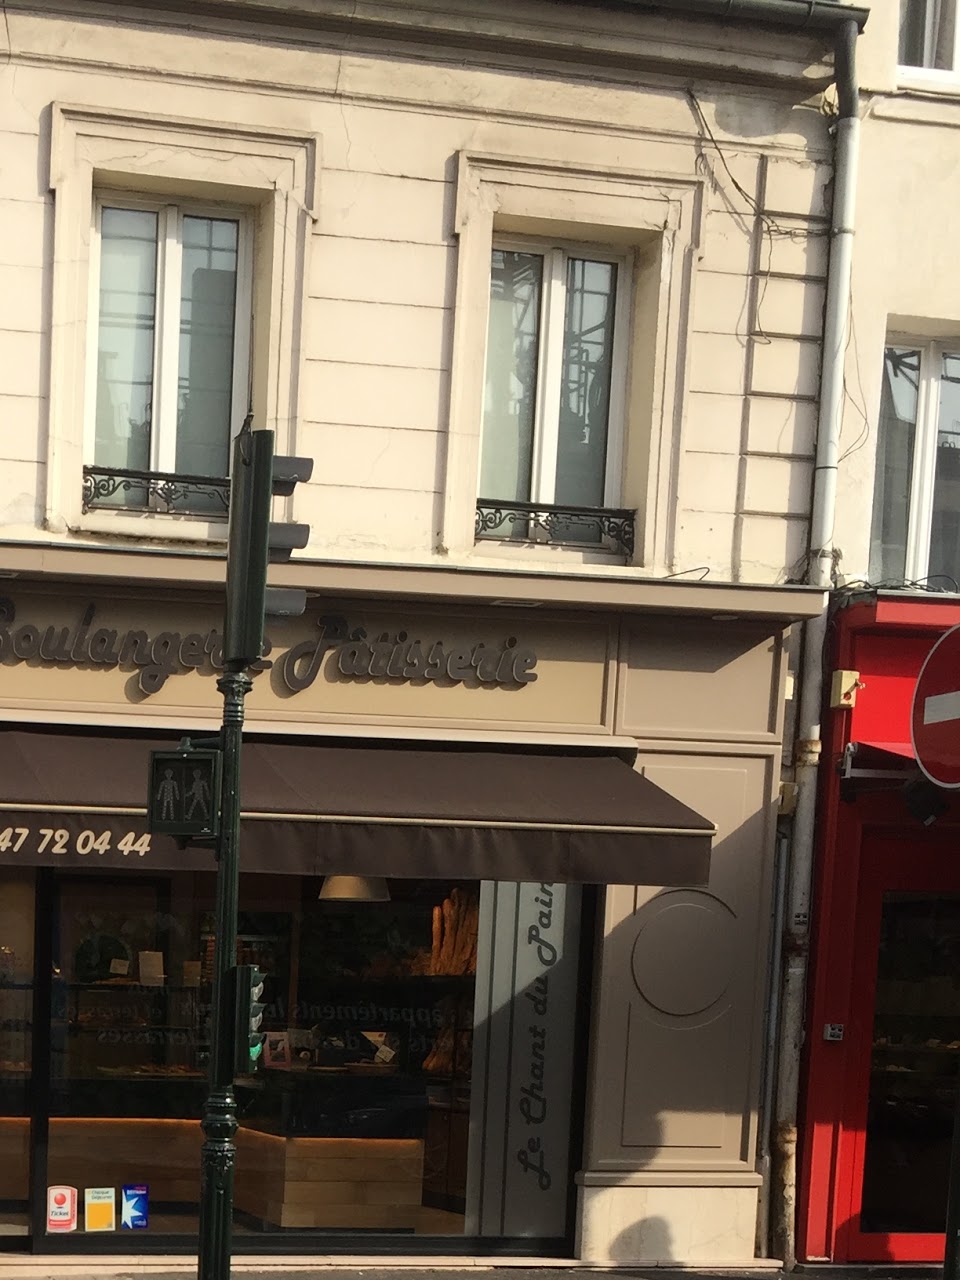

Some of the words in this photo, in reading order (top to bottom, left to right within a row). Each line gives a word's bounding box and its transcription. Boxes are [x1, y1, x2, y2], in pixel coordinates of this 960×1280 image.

[283, 614, 538, 692] Pâtisserie
[37, 828, 70, 854] 72
[76, 830, 111, 855] 04
[117, 831, 152, 856] 44
[525, 975, 549, 1017] du
[519, 1024, 548, 1126] Chant
[517, 1137, 552, 1191] Le
